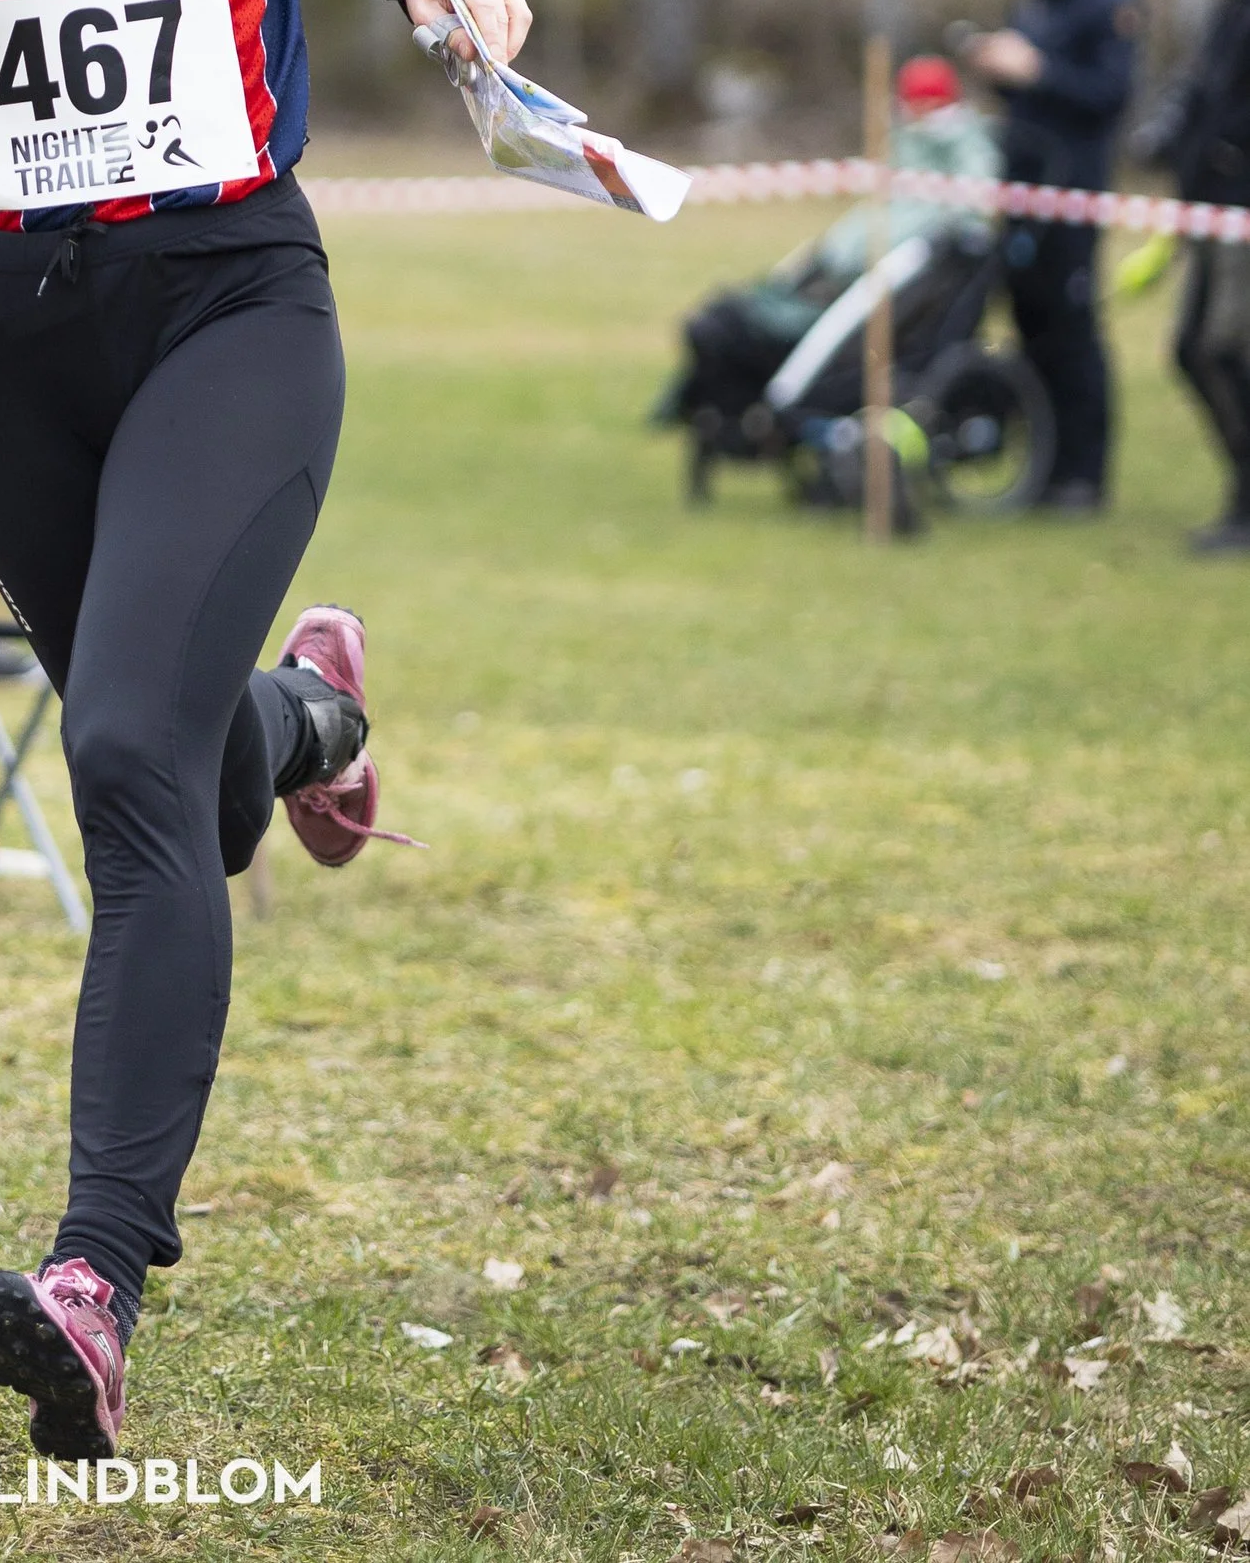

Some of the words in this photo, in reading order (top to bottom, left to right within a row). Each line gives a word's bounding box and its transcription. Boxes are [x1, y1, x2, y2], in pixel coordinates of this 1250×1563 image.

[10, 126, 99, 165] NIGHT
[100, 121, 135, 185] RUN
[14, 162, 105, 196] TRAIL
